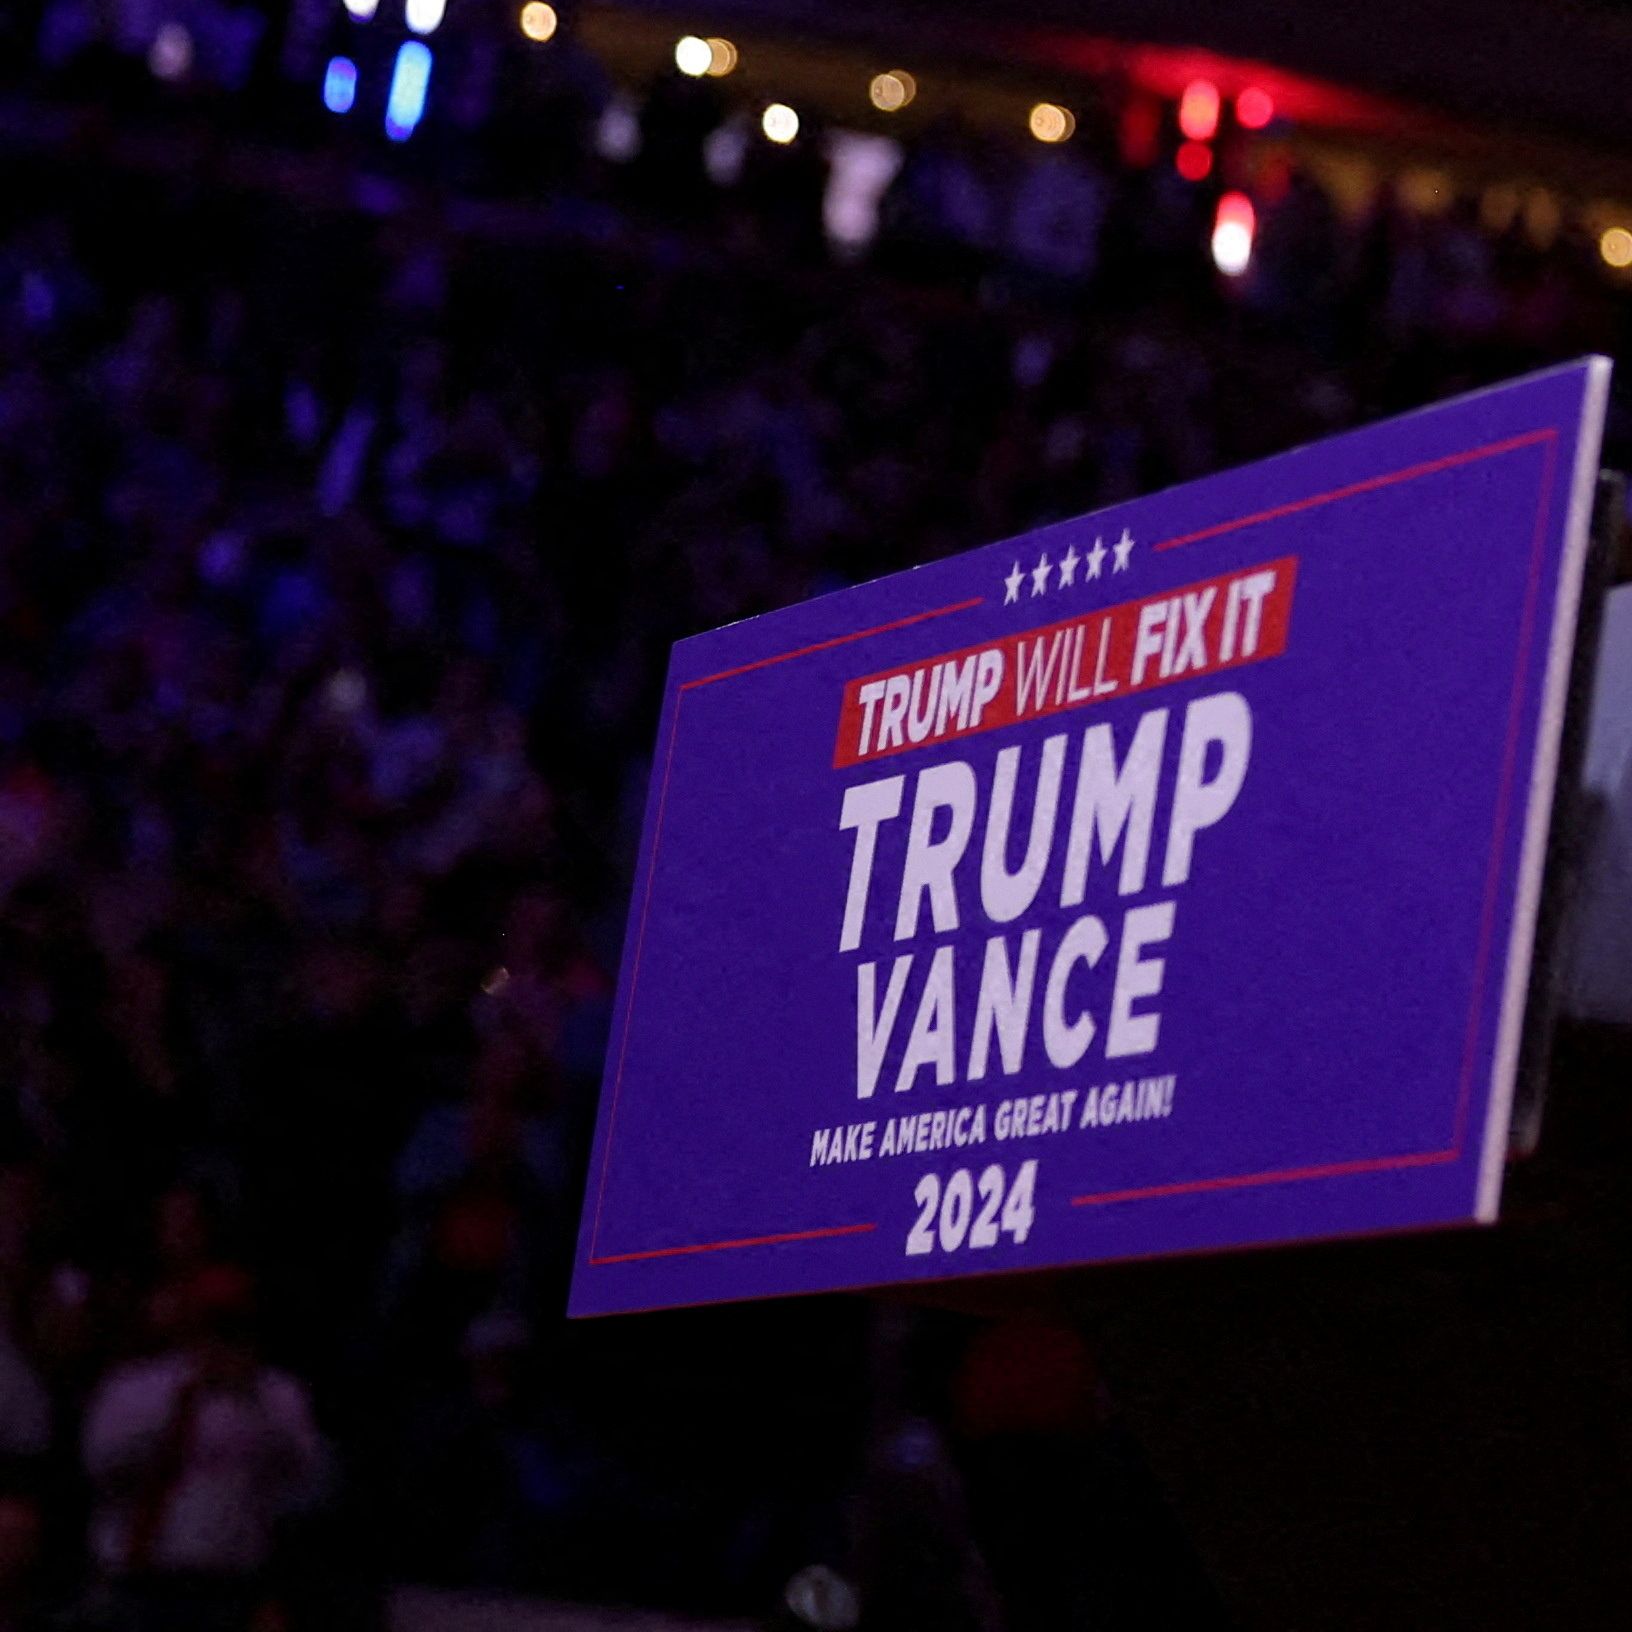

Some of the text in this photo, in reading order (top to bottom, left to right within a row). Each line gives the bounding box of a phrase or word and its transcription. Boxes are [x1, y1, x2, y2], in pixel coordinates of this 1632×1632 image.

[858, 570, 1276, 756] TRUMP WILL FIX IT
[839, 691, 1252, 953] TRUMP
[856, 901, 1176, 1100] VANCE
[810, 1076, 1175, 1167] MAKE AMERICA GREAT AGAIN!
[905, 1159, 1038, 1255] 2024
